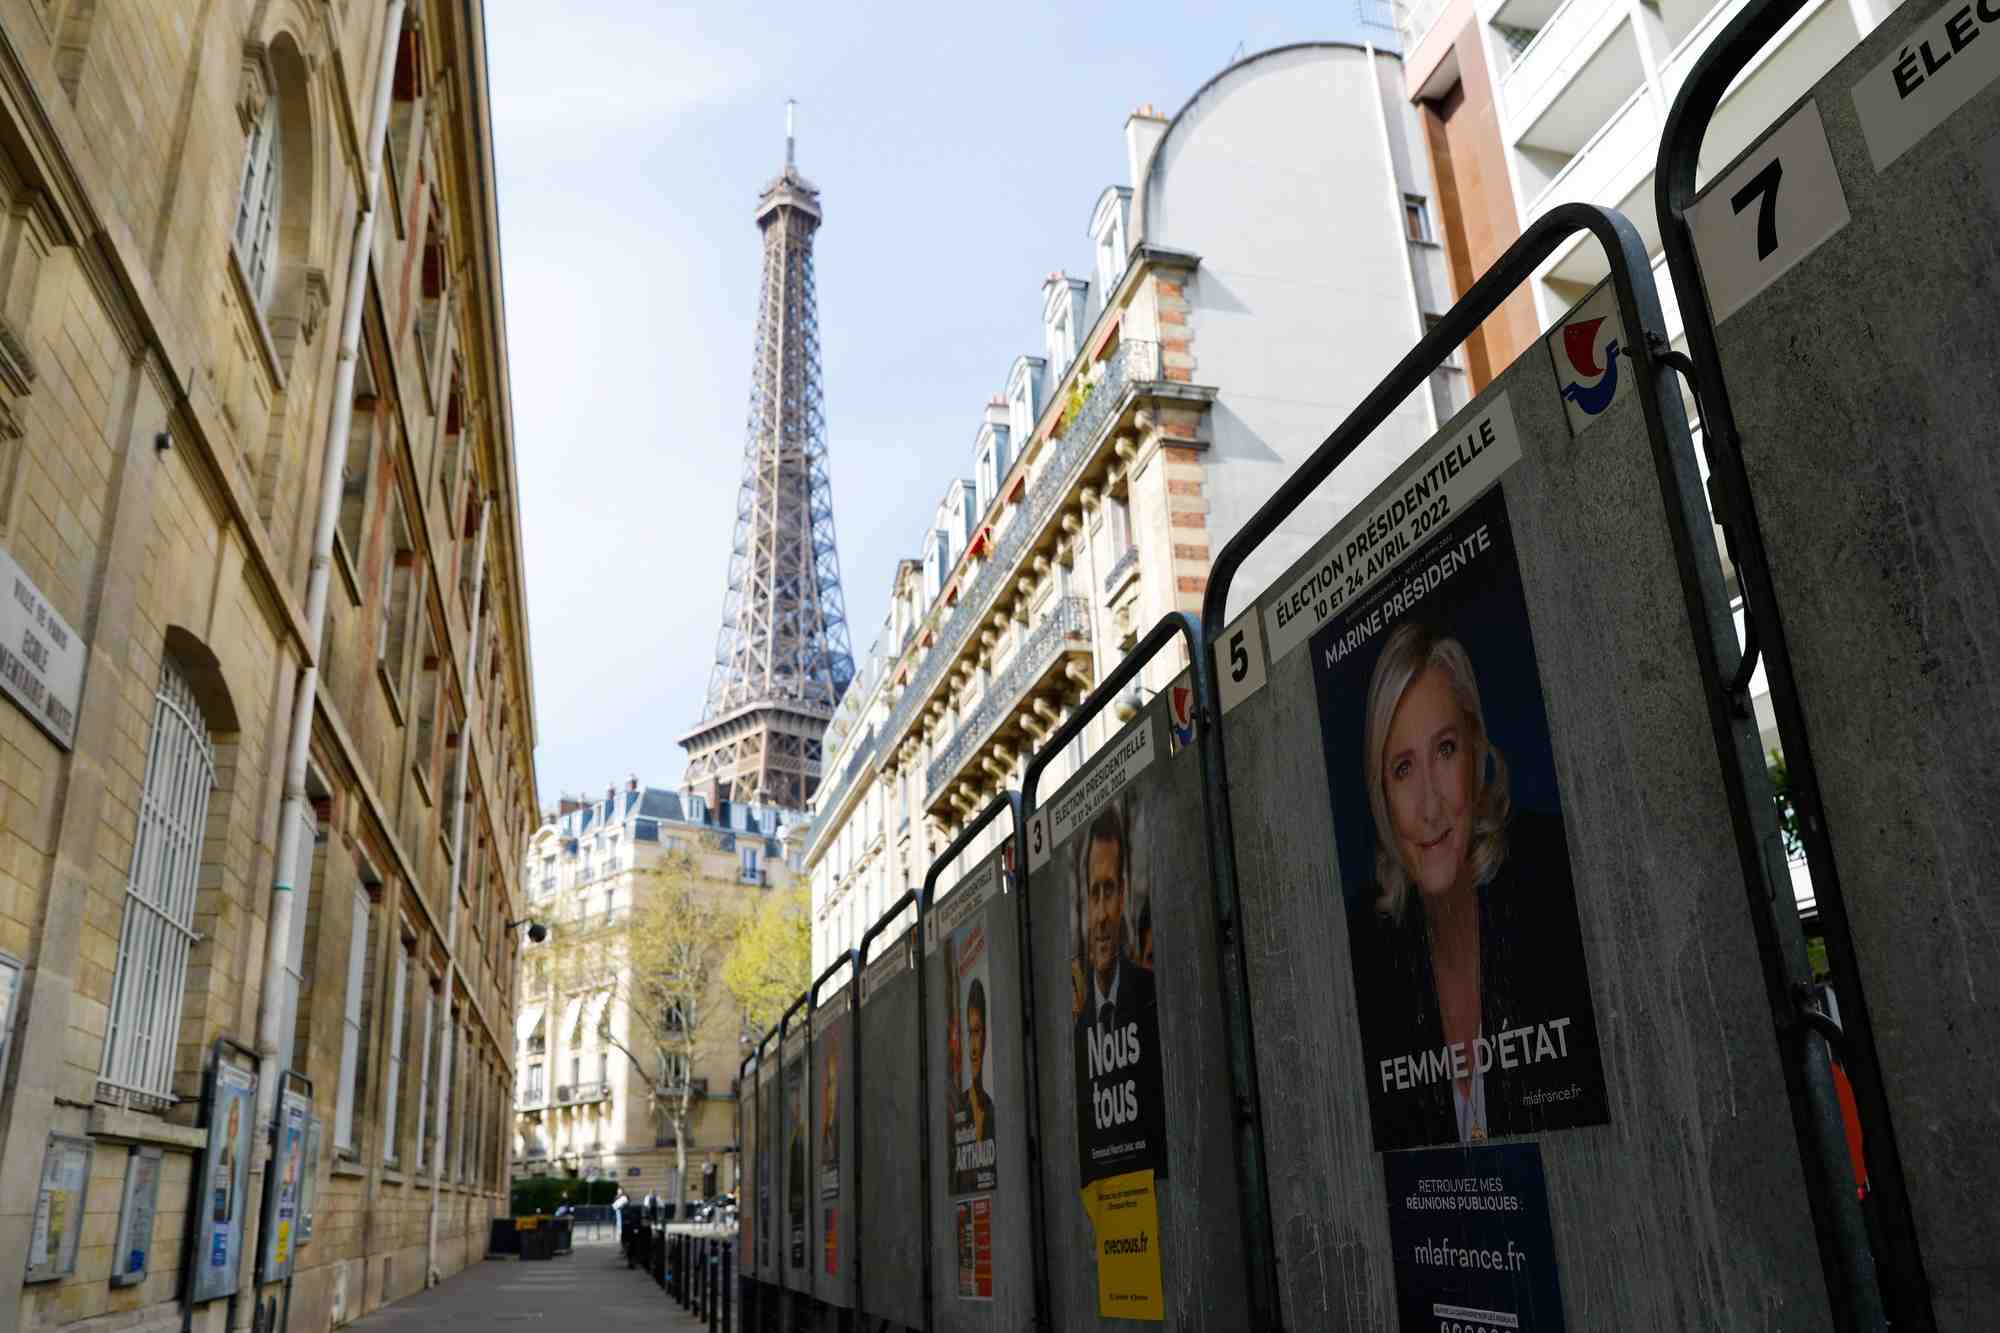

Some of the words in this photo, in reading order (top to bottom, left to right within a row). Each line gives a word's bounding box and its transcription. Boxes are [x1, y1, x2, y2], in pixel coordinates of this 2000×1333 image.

[1730, 158, 1783, 262] 7
[1276, 554, 1344, 628] ÉLECTION
[1346, 418, 1496, 566] PRÉSIDENTIELLE
[1313, 599, 1328, 622] 10
[1331, 590, 1344, 610] ET
[1346, 570, 1364, 596] 24
[1367, 535, 1410, 580] AVRIL
[1411, 495, 1450, 540] 2022
[1324, 615, 1382, 669] MARINE
[1384, 523, 1492, 624] PRÉSIDENTE
[1229, 630, 1249, 682] 5
[1033, 820, 1043, 854] 3
[1087, 1021, 1140, 1079] Nous
[1379, 1042, 1469, 1094] FEMME
[1472, 1017, 1571, 1074] D'ÉTAT
[1093, 1078, 1138, 1131] tous
[1522, 1083, 1582, 1106] mlafrance.fr
[1406, 1193, 1456, 1210] RÉUNIONS
[1458, 1195, 1519, 1212] PUBLIQUES
[1418, 1178, 1476, 1193] RETROUVEZ
[1480, 1177, 1503, 1192] MES
[1414, 1238, 1526, 1272] mlafrance.fr
